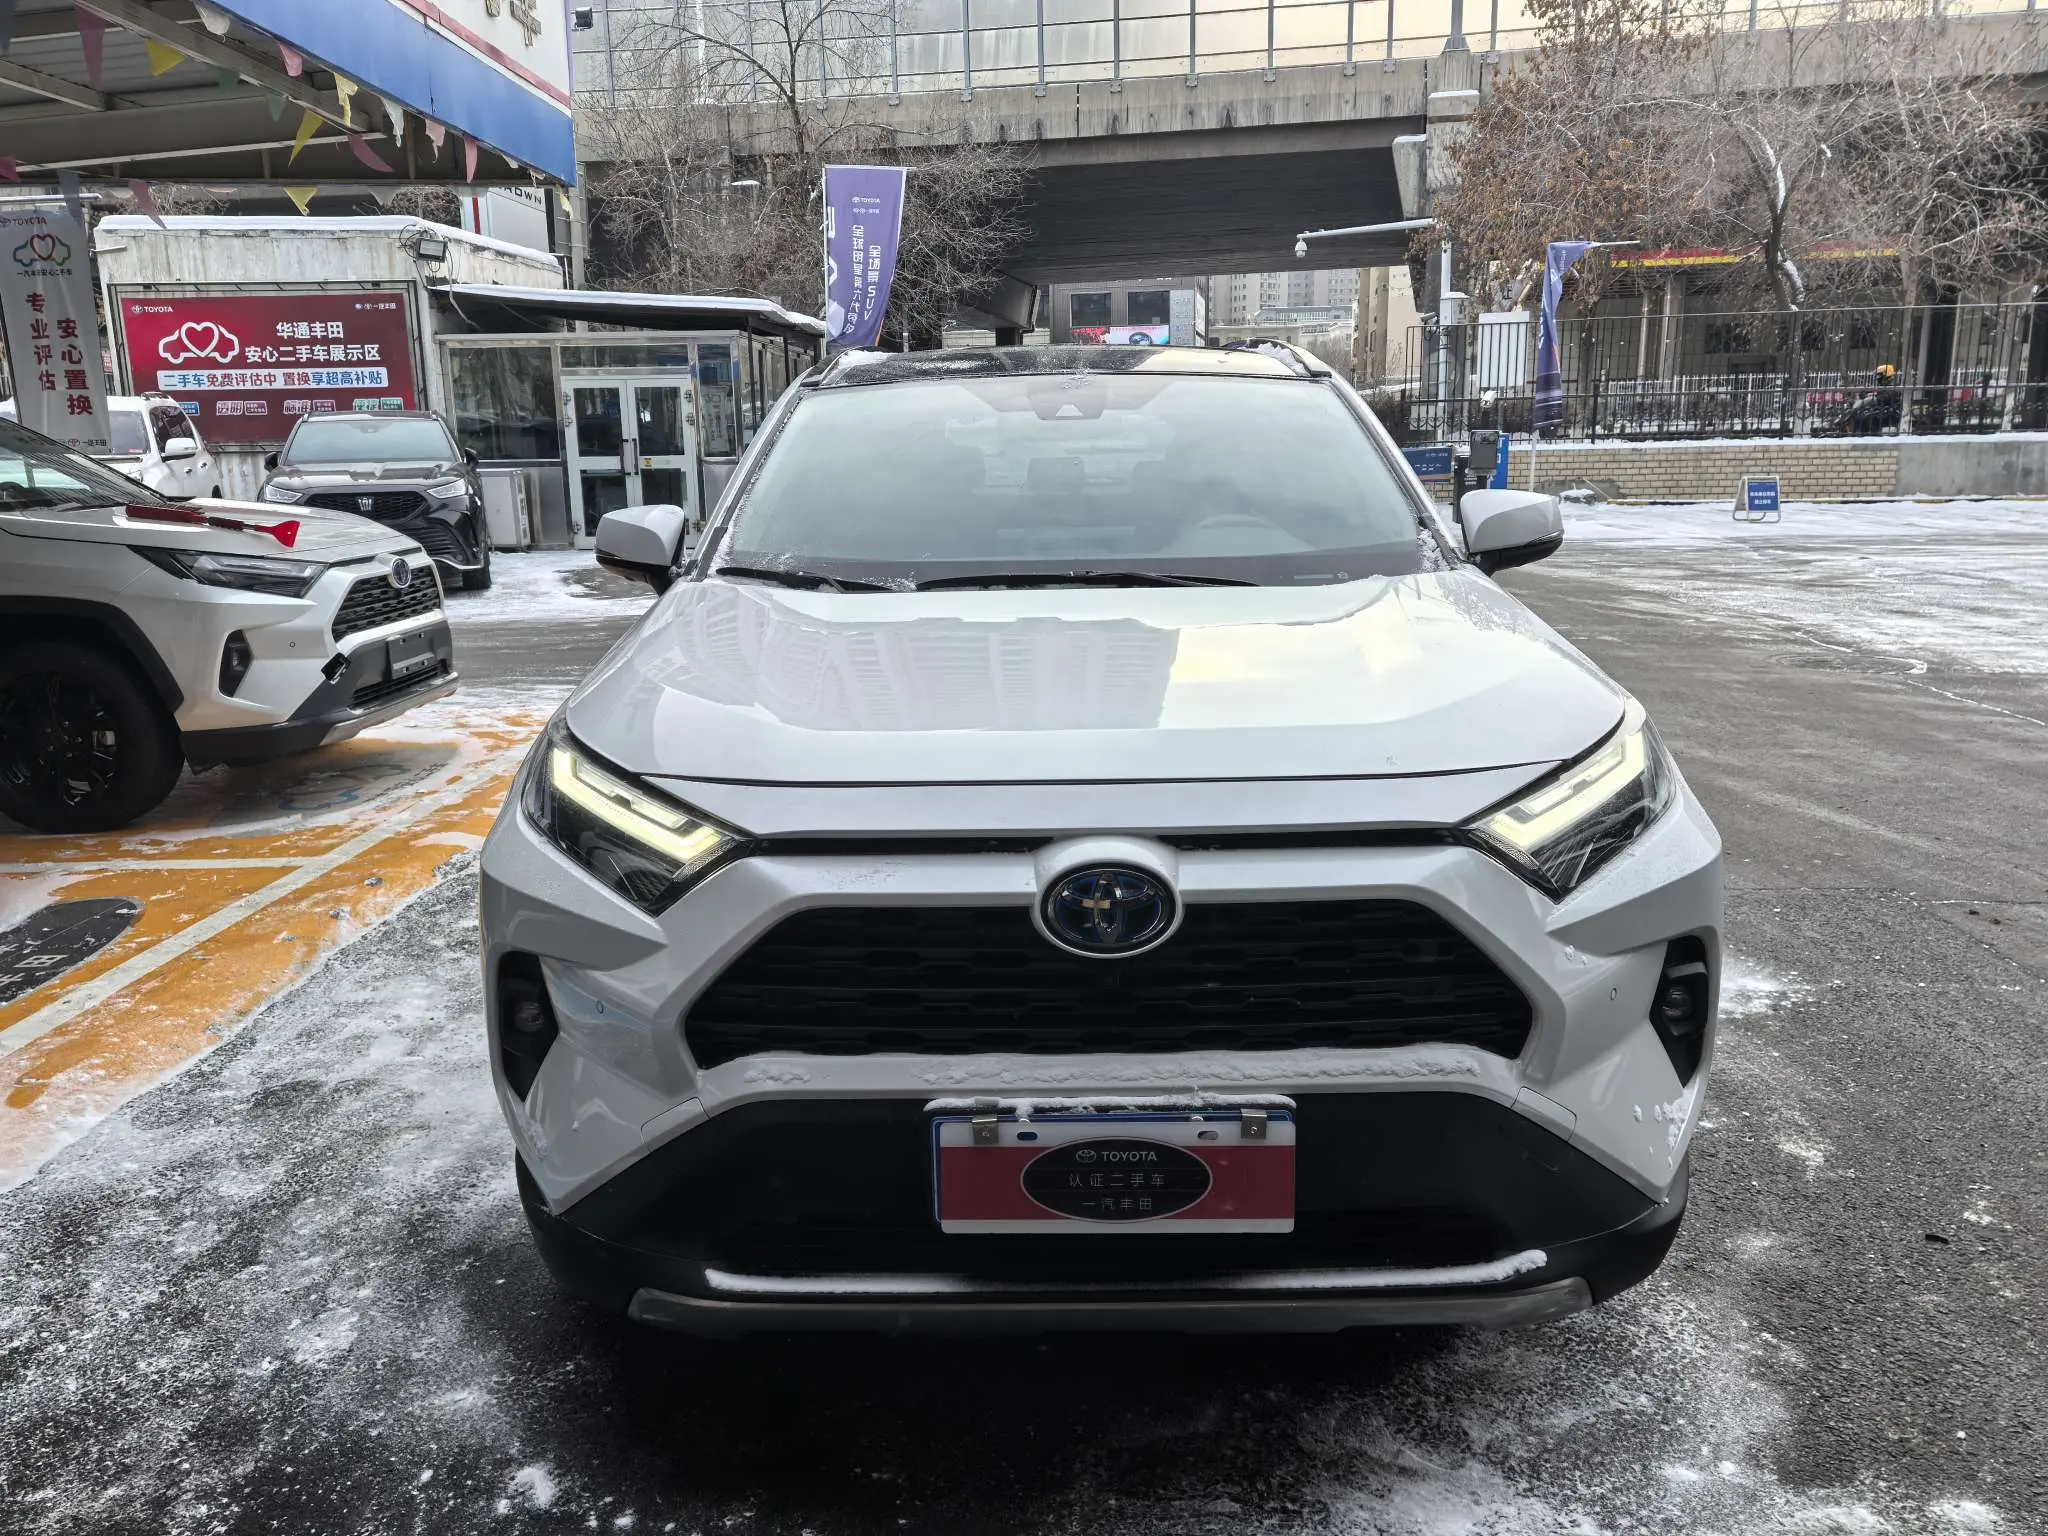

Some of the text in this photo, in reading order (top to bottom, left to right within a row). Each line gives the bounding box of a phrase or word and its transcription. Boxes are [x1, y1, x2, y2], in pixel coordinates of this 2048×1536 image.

[276, 321, 344, 339] 华通丰田
[25, 292, 57, 393] 专业评估
[244, 344, 381, 363] 安心二手车展示区
[56, 317, 94, 416] 安心置换
[163, 370, 383, 388] 二手车免费评估中 置换享超高补贴
[1102, 1151, 1157, 1162] TOYOTA
[1069, 1173, 1165, 1188] 认证二手车
[1082, 1198, 1152, 1211] 一汽丰田
